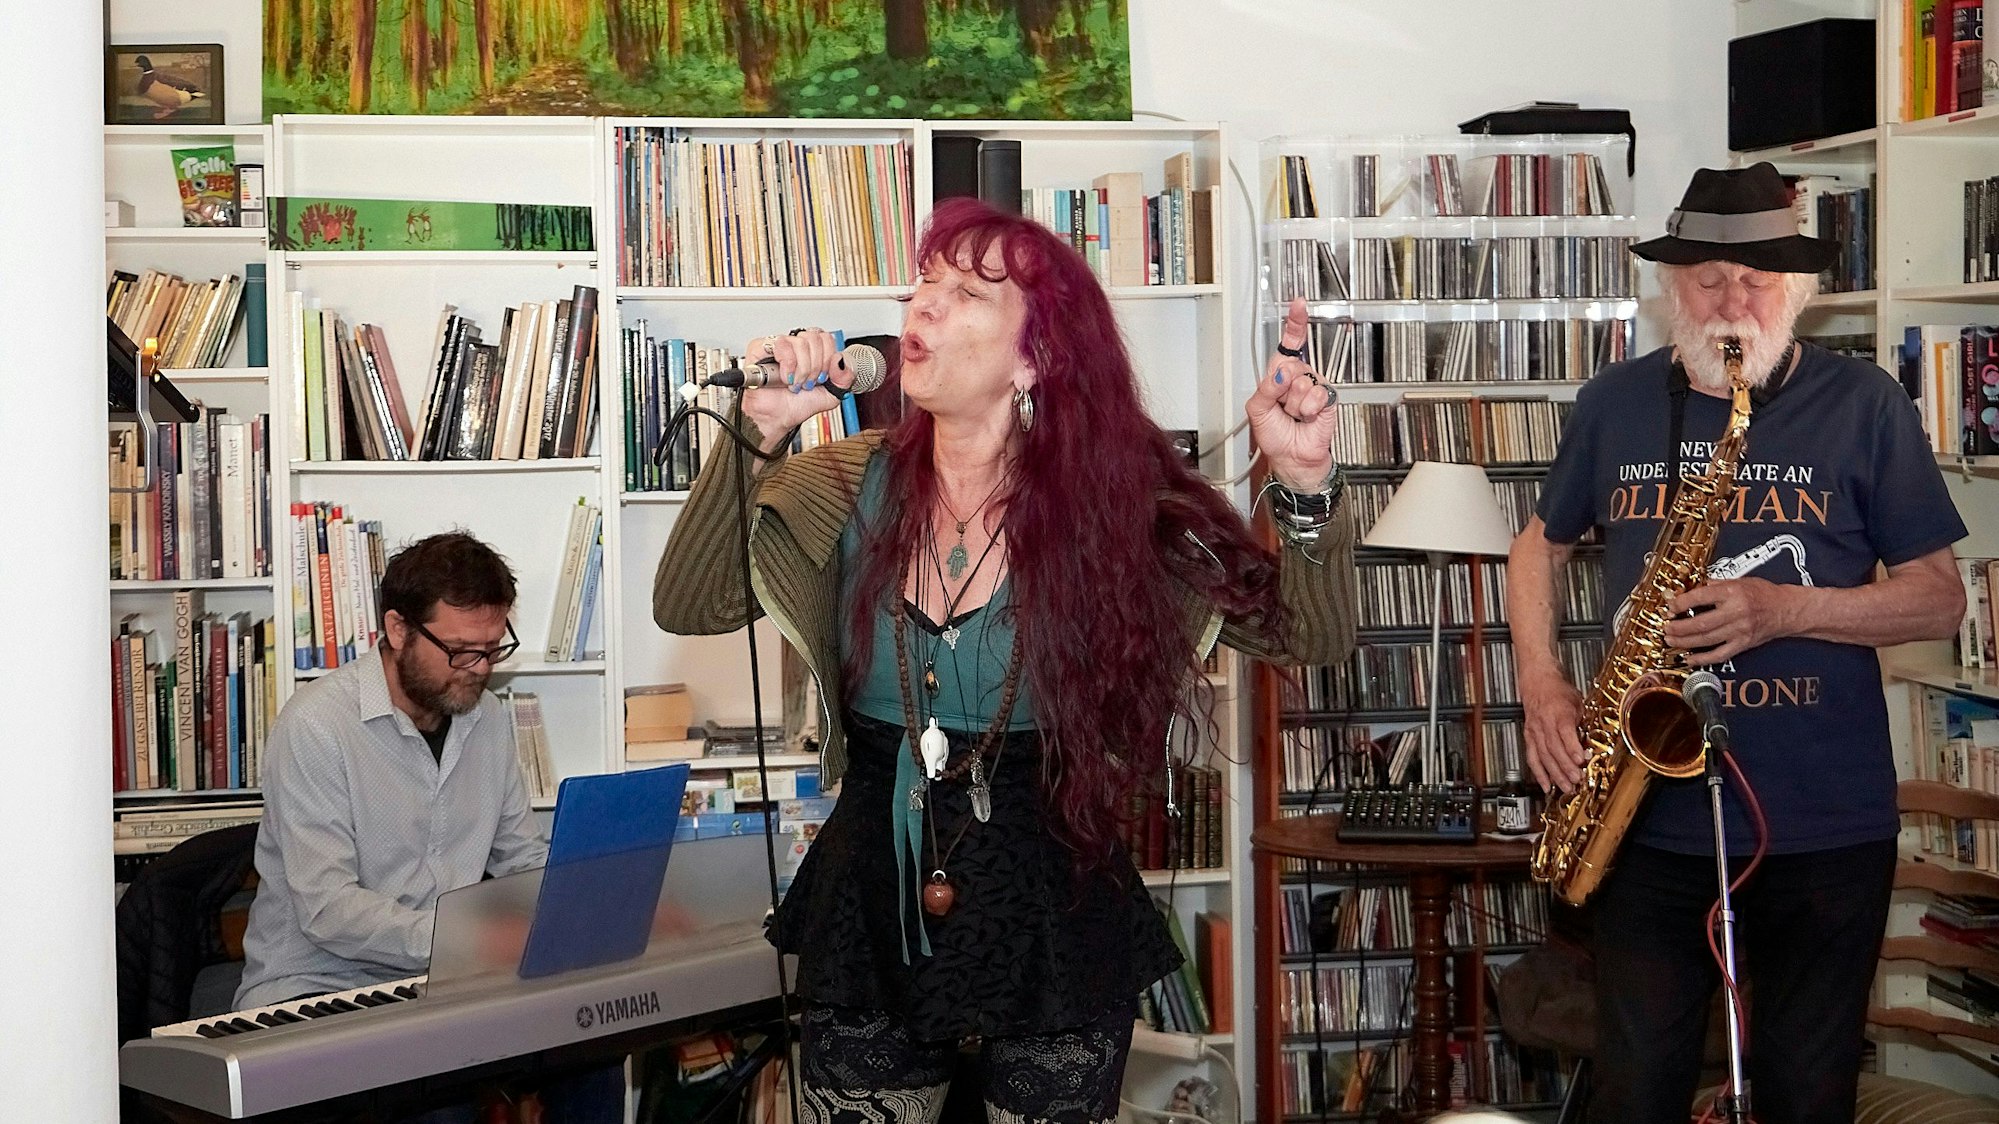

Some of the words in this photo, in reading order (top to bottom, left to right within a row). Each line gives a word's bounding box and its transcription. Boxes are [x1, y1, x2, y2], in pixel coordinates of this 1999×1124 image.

[179, 155, 227, 179] Trolli
[697, 350, 707, 395] HLLAND
[226, 439, 239, 478] Manet
[1785, 465, 1813, 485] AN
[161, 469, 172, 521] KANDINSKY
[163, 521, 173, 557] WASSILY
[295, 525, 307, 577] Malschule
[319, 556, 335, 643] AKTZEICHNEN
[175, 595, 189, 640] GOGH
[131, 648, 143, 694] RENOIR
[178, 646, 190, 675] VAN
[214, 647, 224, 692] VERMEER
[133, 695, 145, 713] BEI
[215, 695, 224, 713] JAN
[1720, 676, 1820, 708] HONE
[179, 680, 193, 741] VINCENT
[135, 714, 146, 744] GAST
[136, 745, 147, 762] ZU
[130, 820, 174, 837] Graphik
[595, 990, 661, 1025] YAMAHA
